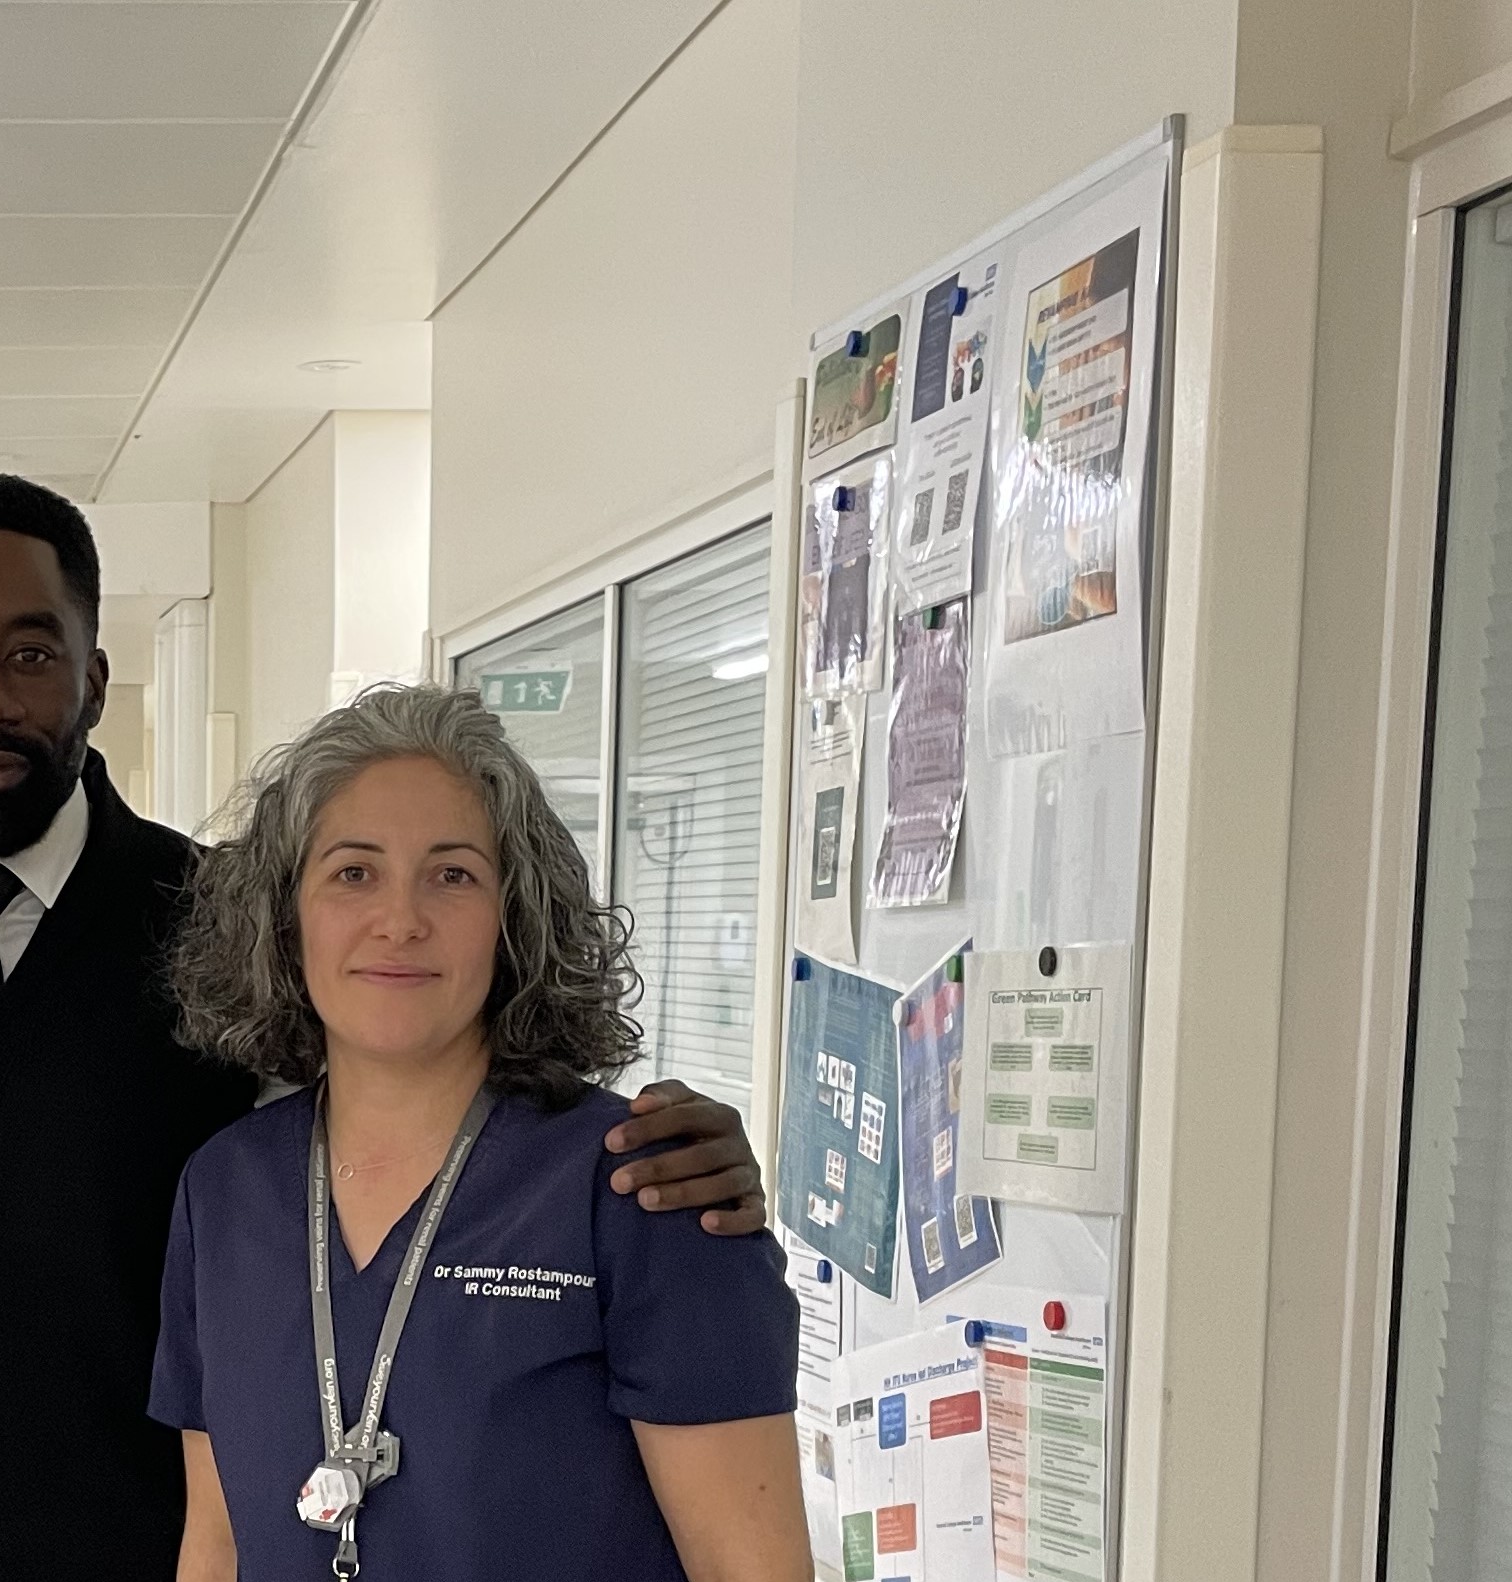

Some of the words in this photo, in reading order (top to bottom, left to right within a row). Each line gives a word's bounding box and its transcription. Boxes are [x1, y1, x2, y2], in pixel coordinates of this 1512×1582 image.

[442, 1134, 472, 1182] Preserving
[314, 1179, 324, 1202] renal
[434, 1182, 449, 1206] veins
[314, 1204, 324, 1217] for
[428, 1207, 440, 1222] for
[418, 1222, 432, 1247] renal
[316, 1243, 325, 1292] Preserving
[404, 1246, 423, 1286] patients
[433, 1265, 451, 1278] Dr
[453, 1265, 505, 1282] Sammy
[508, 1266, 596, 1288] Rostampour
[465, 1282, 479, 1295] IR
[482, 1283, 562, 1301] Consultant
